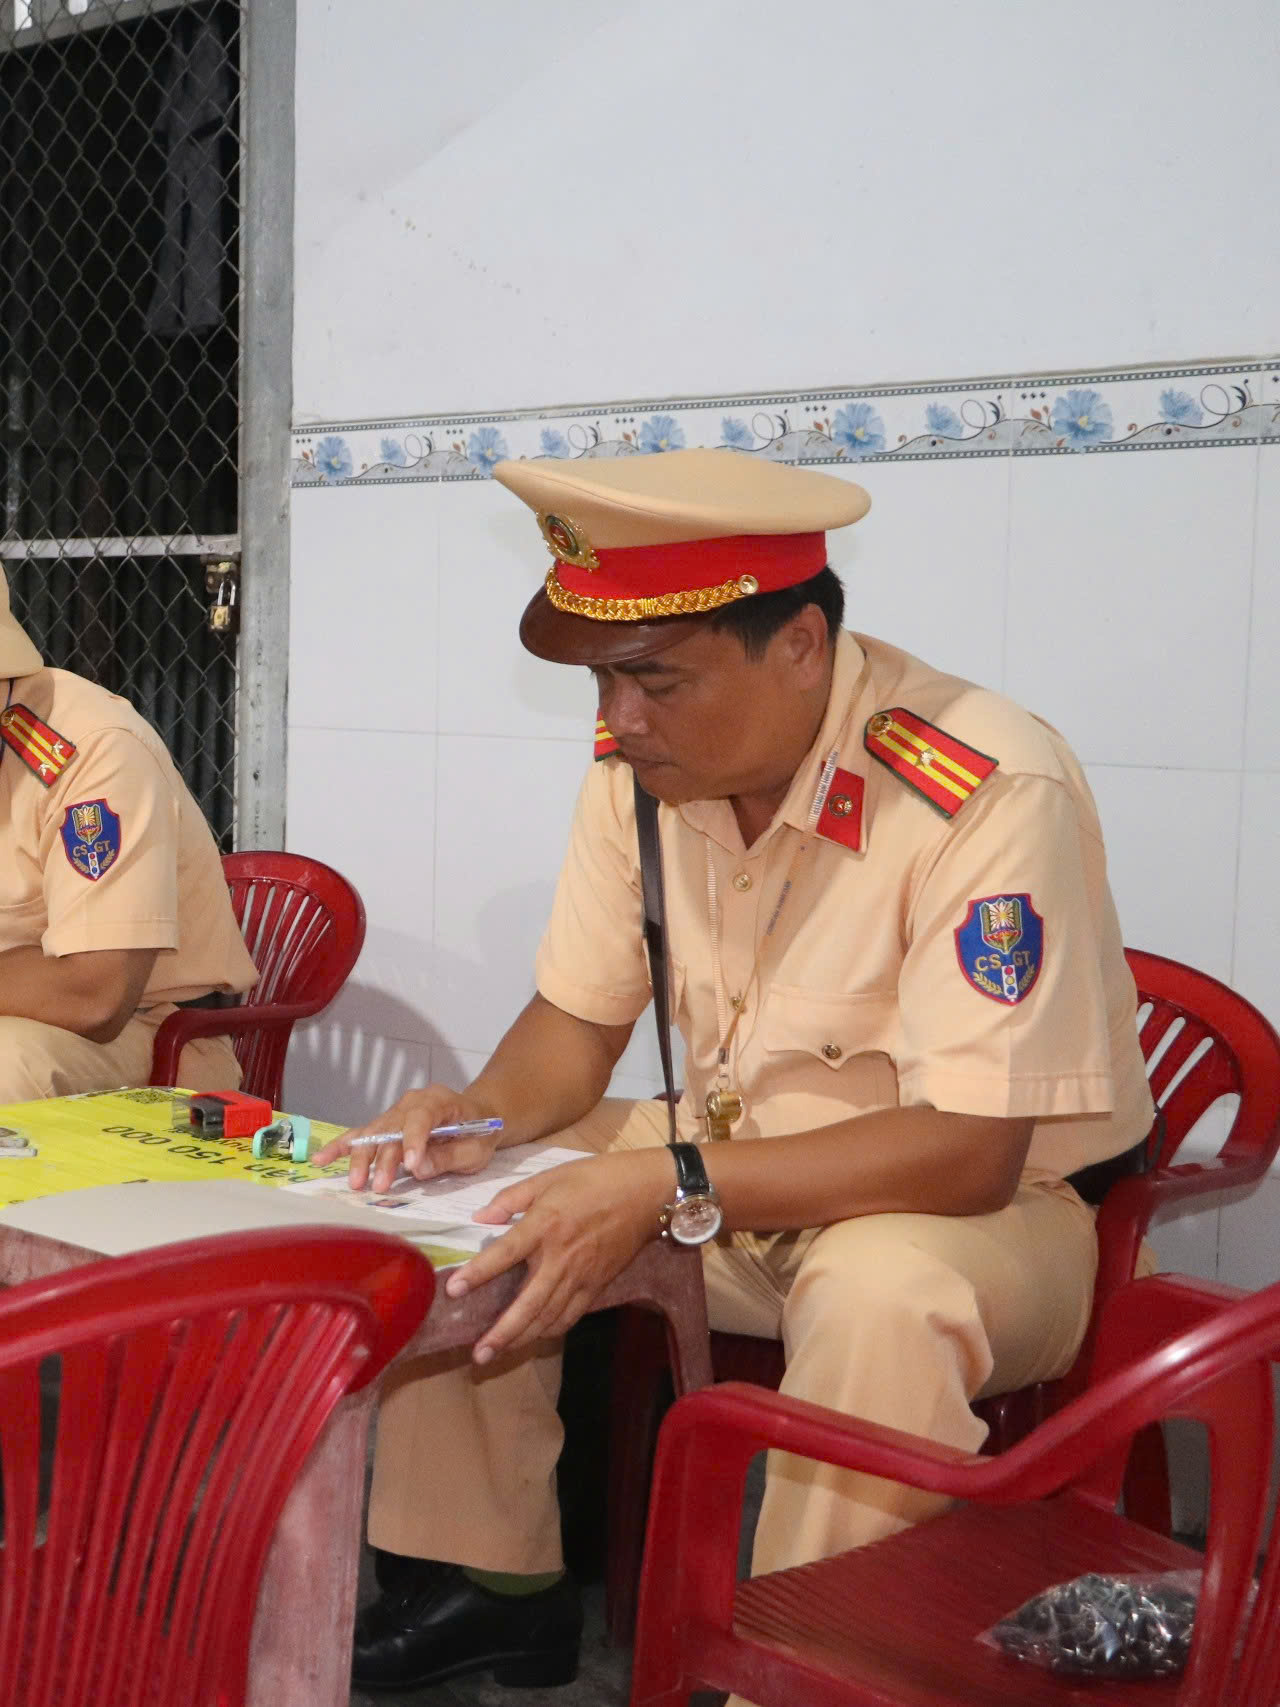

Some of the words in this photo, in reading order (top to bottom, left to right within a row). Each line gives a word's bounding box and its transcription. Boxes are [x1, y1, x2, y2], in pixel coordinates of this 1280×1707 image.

[73, 844, 88, 857] CS
[94, 840, 110, 853] GT
[975, 953, 1001, 971] CS
[1013, 950, 1030, 966] GT
[102, 1126, 172, 1145] 000
[168, 1145, 236, 1165] 150
